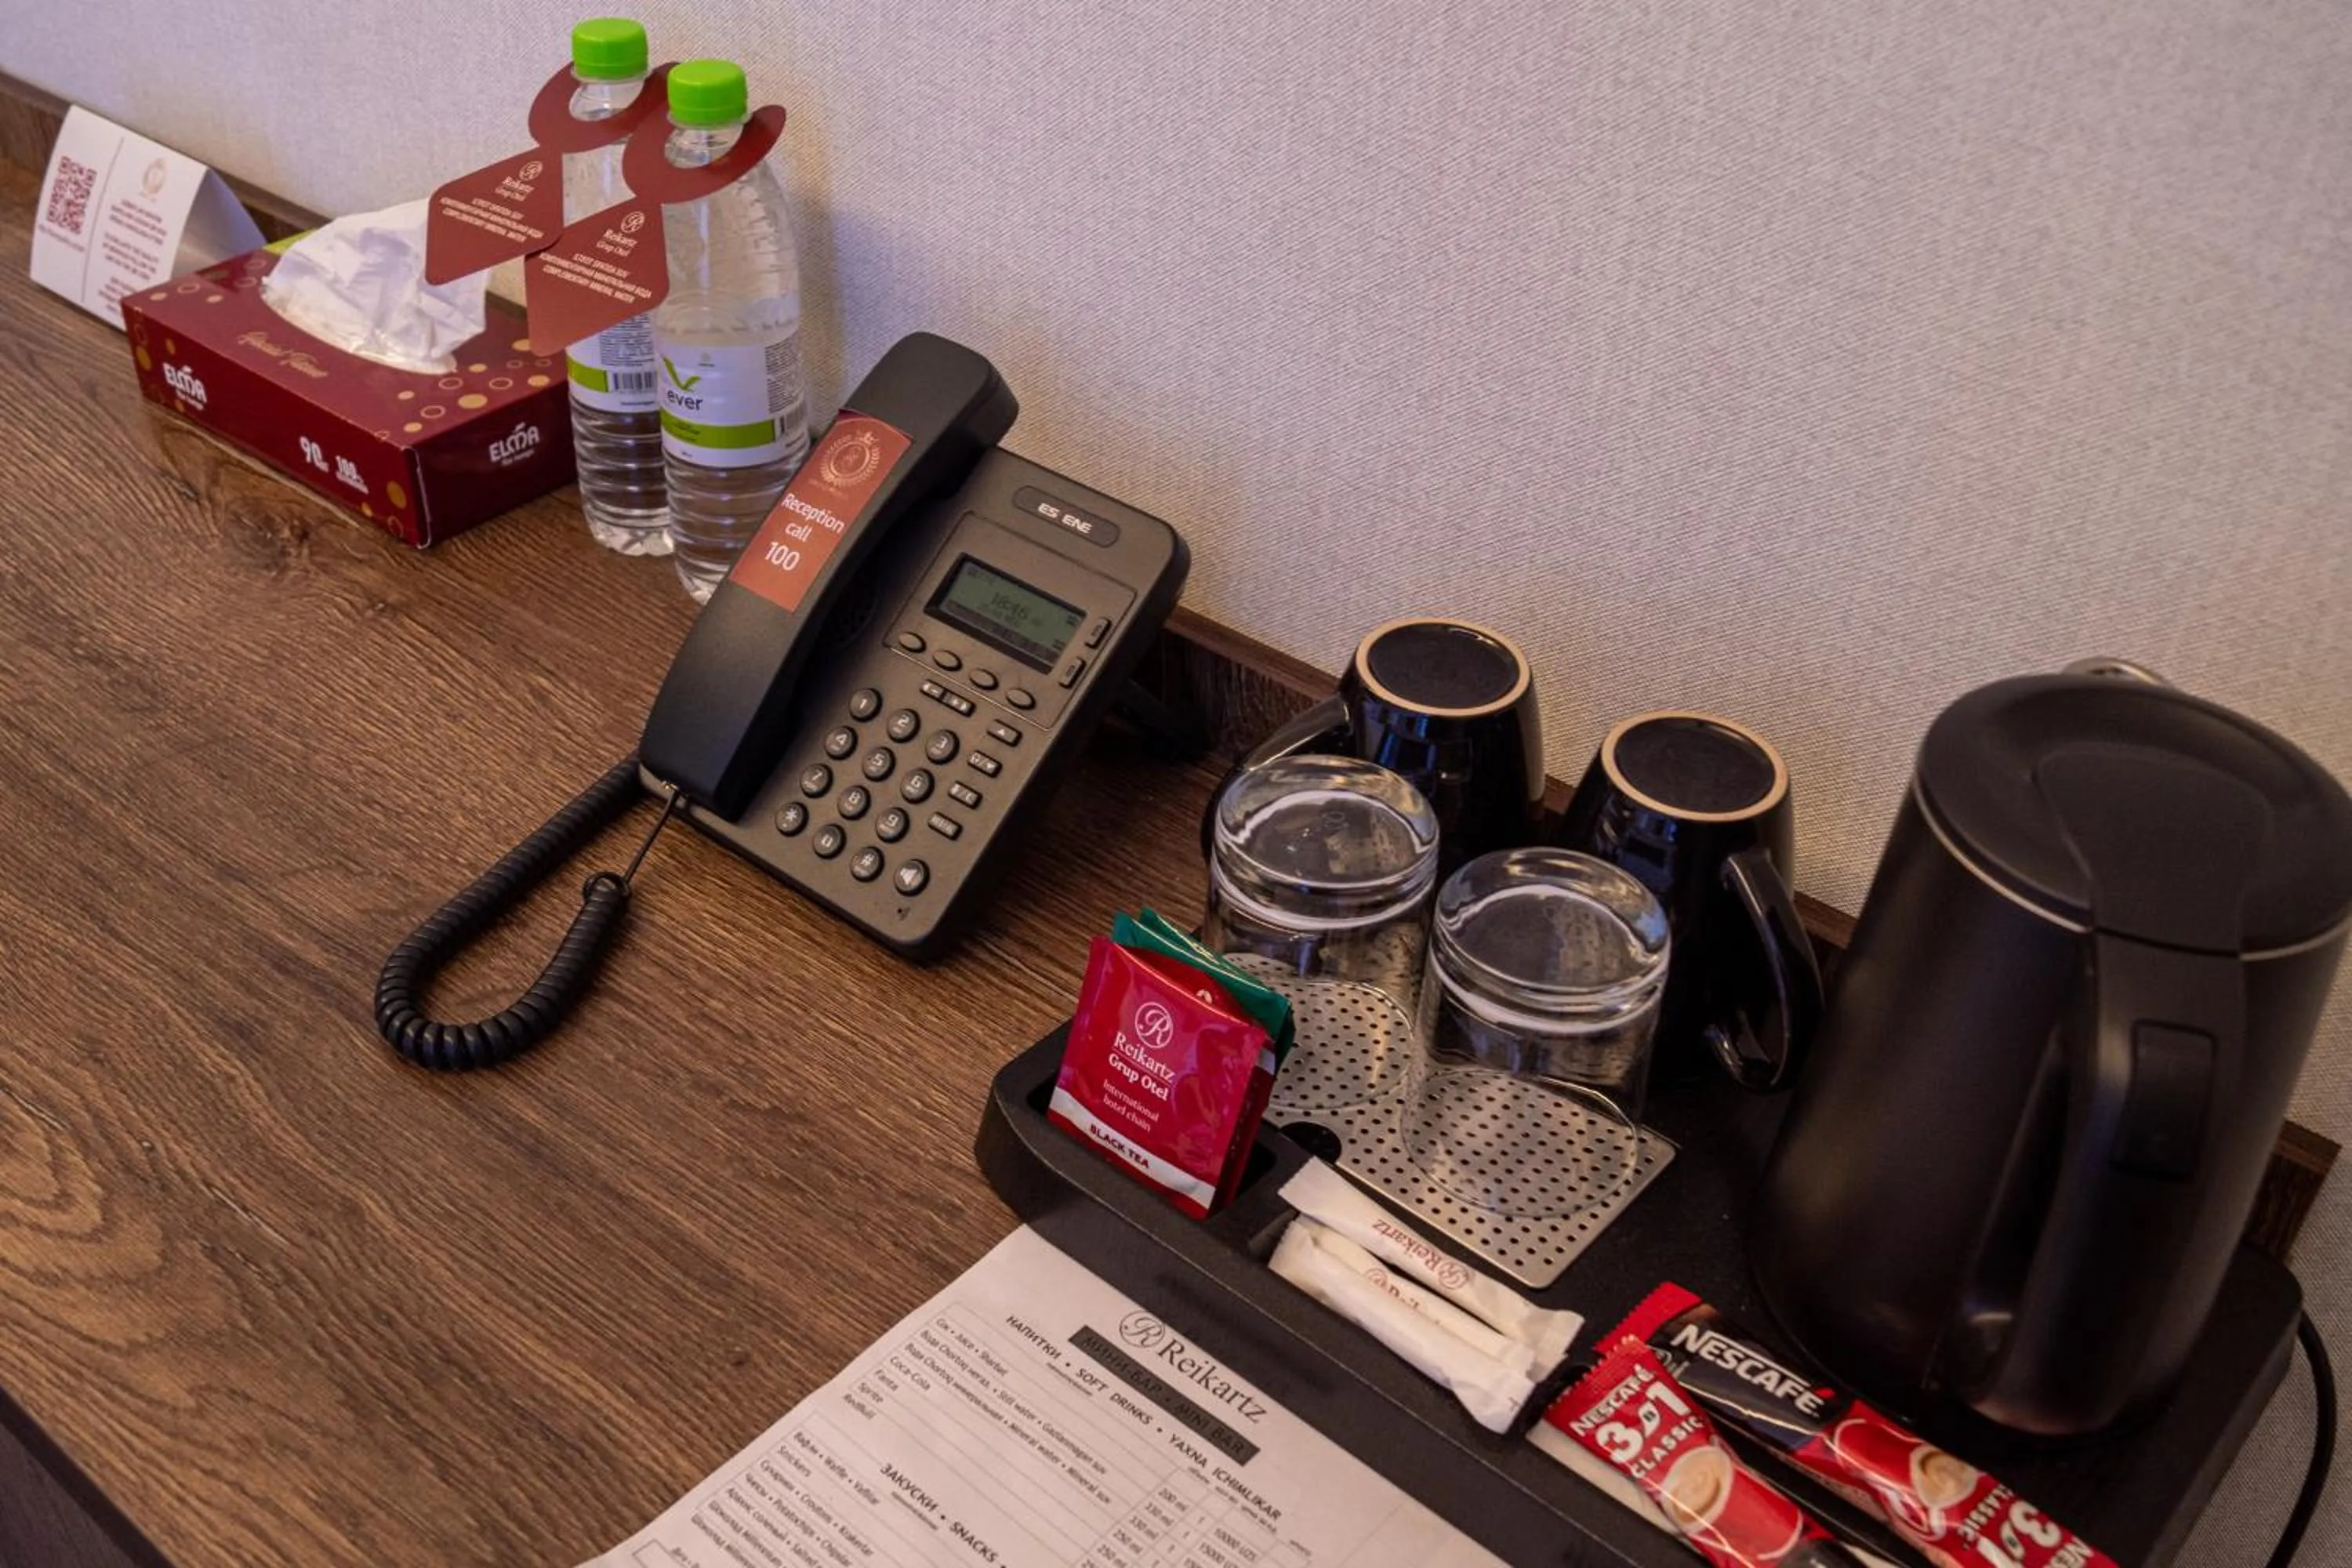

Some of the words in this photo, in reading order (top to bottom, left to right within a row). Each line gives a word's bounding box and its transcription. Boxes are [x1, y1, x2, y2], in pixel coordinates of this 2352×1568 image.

[782, 492, 844, 534] Reception
[785, 521, 813, 543] call
[764, 541, 800, 572] 100
[1109, 1053, 1139, 1083] Grup
[1141, 1076, 1169, 1102] Otel
[1113, 1031, 1175, 1083] Reikartz
[1103, 1079, 1160, 1123] International
[1104, 1094, 1127, 1117] hotel
[1126, 1111, 1151, 1133] chain
[1090, 1123, 1126, 1155] BLACK
[1127, 1148, 1150, 1169] TEA
[1372, 1219, 1443, 1271] Reikartz
[858, 1382, 884, 1403] Sprite
[874, 1369, 898, 1391] Fanta
[890, 1356, 931, 1391] Coca-Cola
[1156, 1338, 1267, 1423] Reikartz
[1006, 1316, 1062, 1359] НАПИТКИ
[1075, 1367, 1109, 1391] SOFT
[1109, 1392, 1152, 1424] DRINKS
[1169, 1433, 1207, 1468] YAXNA
[1211, 1467, 1281, 1520] ICHIMLIKAR
[776, 1445, 811, 1477] Snickers
[1630, 1415, 1704, 1479] CLASSIC
[880, 1464, 938, 1512] ЗАКУСКИ
[949, 1521, 997, 1563] SNACKS
